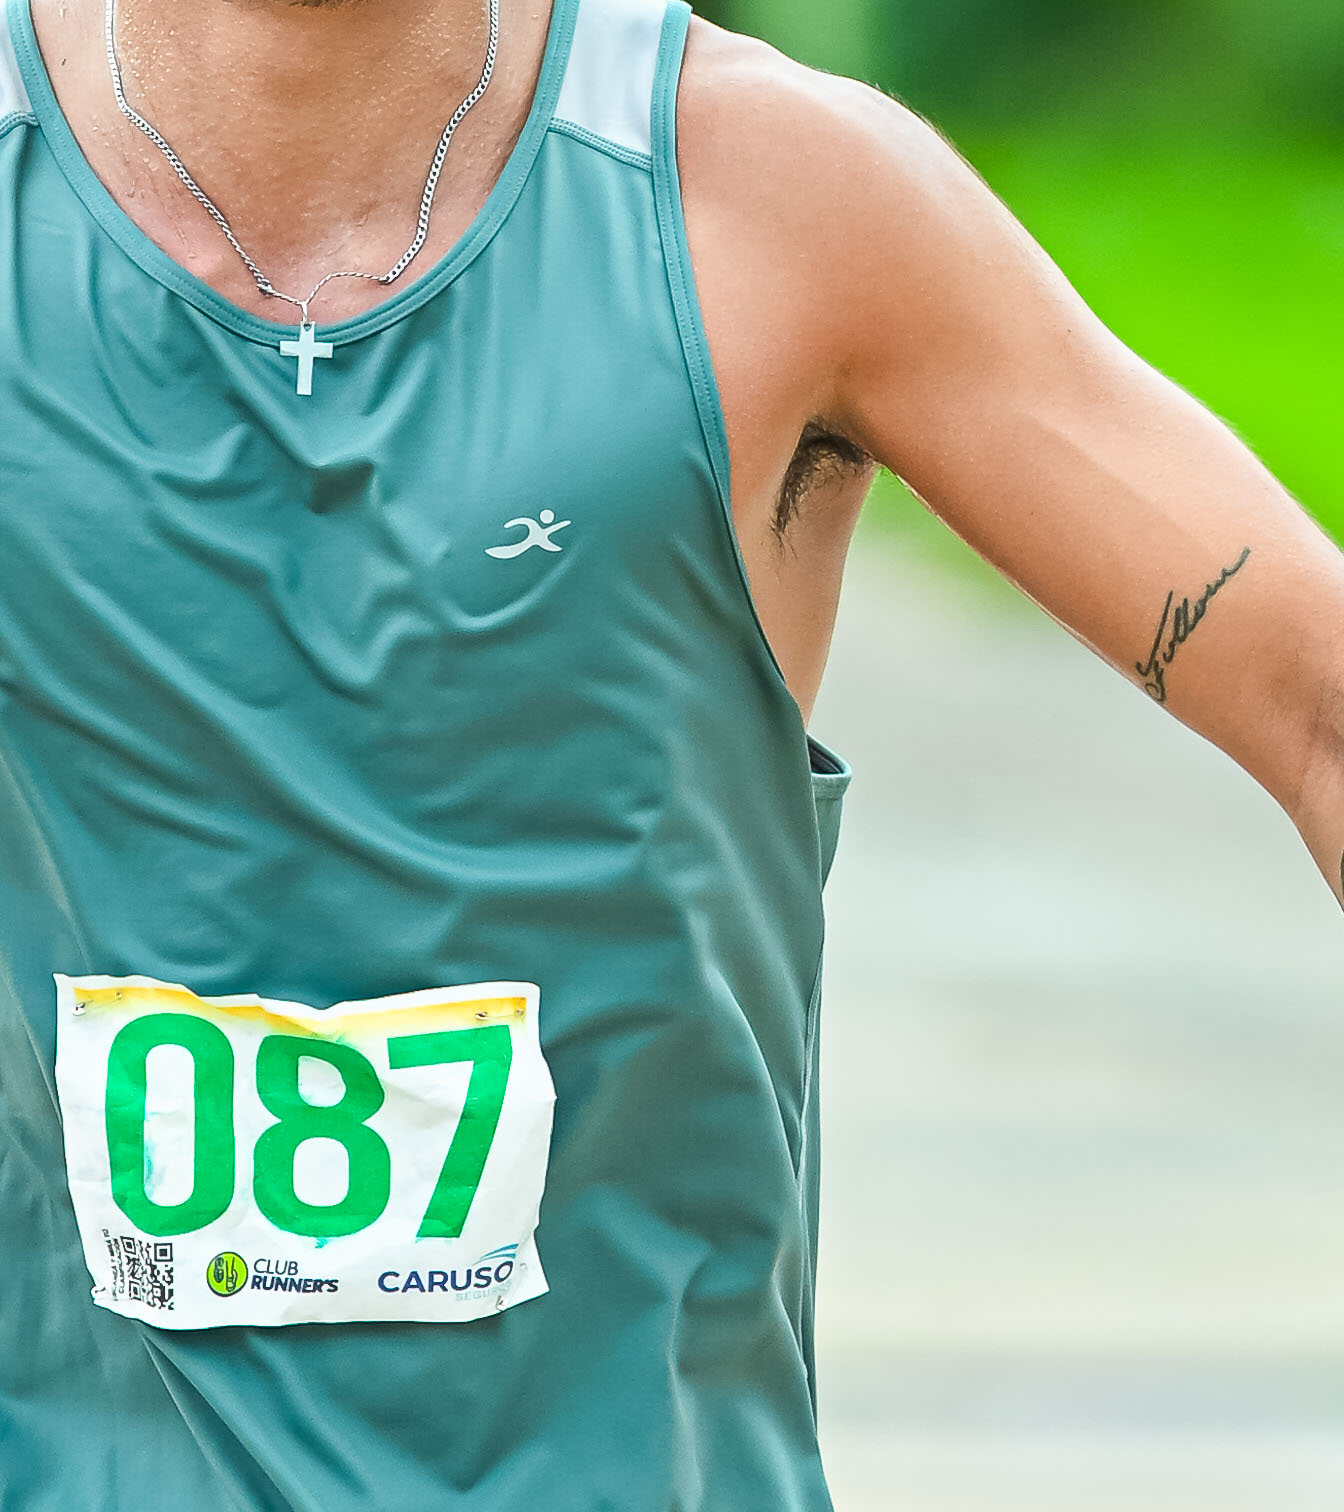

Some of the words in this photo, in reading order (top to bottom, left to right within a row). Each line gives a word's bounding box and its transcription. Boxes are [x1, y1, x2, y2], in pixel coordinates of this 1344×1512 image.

[105, 1012, 513, 1239] 087
[253, 1258, 299, 1276] CLUB
[377, 1260, 514, 1293] CARUSO
[250, 1274, 339, 1293] RUNNER'S
